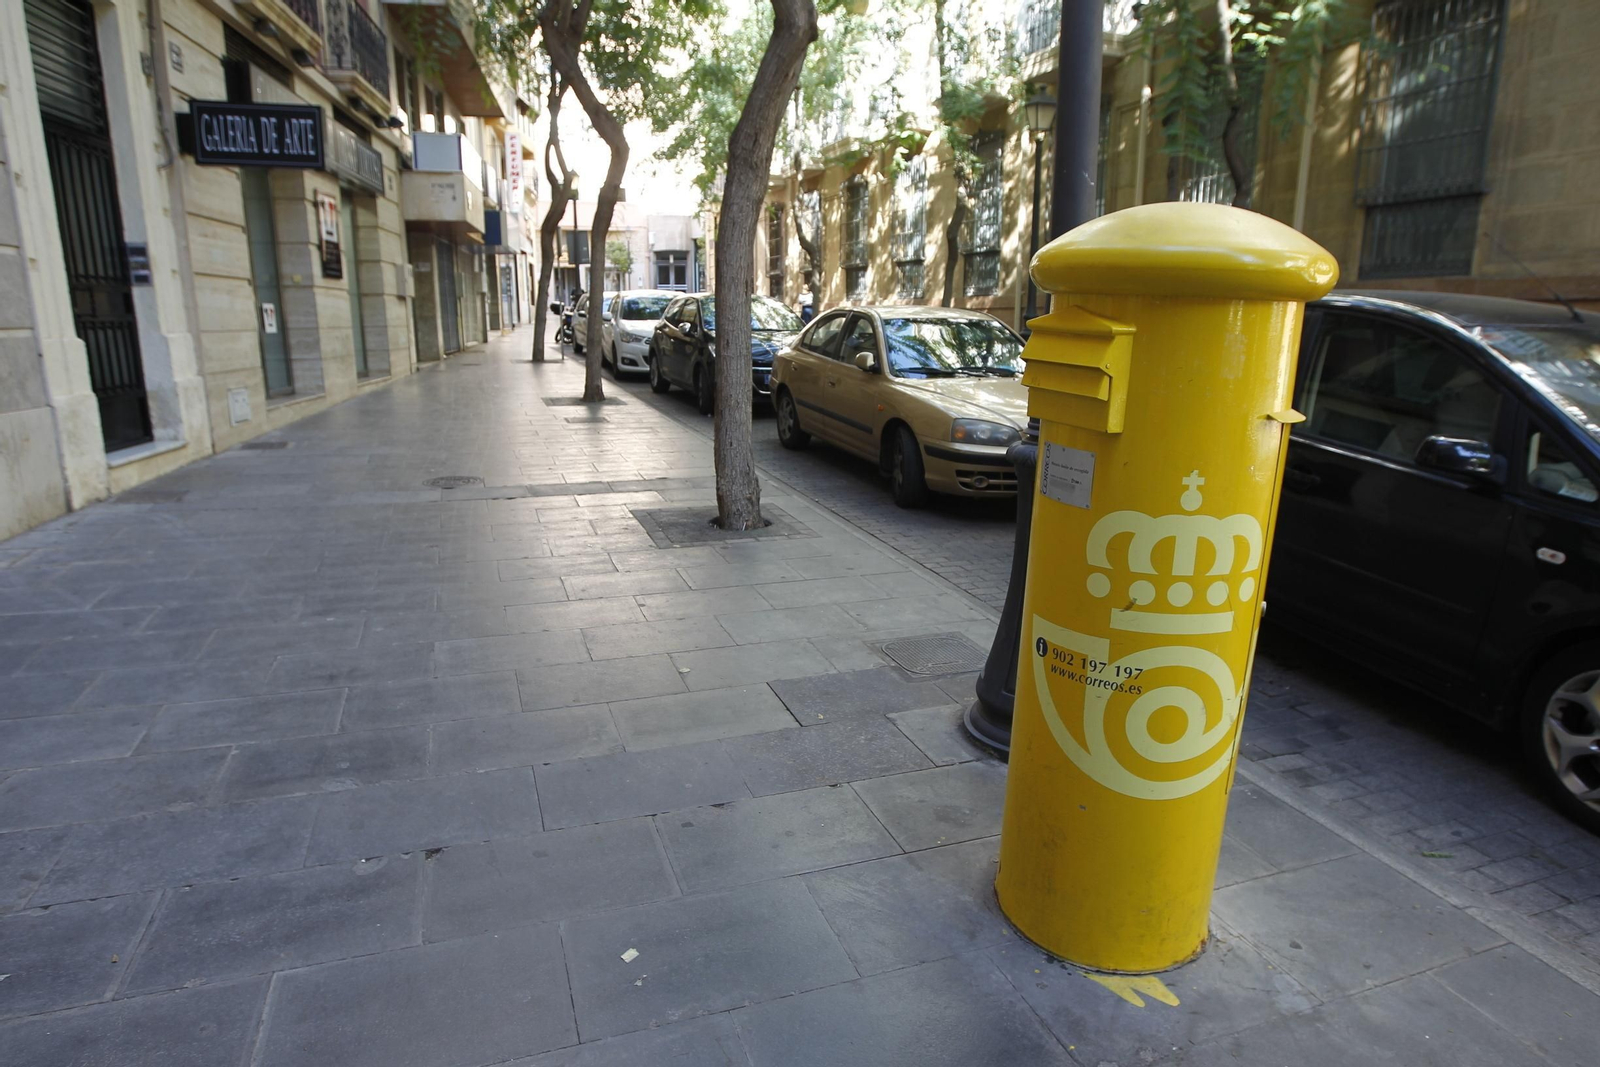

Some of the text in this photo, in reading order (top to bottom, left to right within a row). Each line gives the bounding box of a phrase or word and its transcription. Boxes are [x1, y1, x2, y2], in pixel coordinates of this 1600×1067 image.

[201, 113, 316, 156] GALERIA DE ARTE
[509, 135, 520, 205] PERFUMER
[1042, 443, 1052, 495] CORREOS
[1050, 663, 1143, 695] www.correos.es
[1052, 647, 1074, 667] 902
[1081, 657, 1107, 674] 197
[1115, 665, 1144, 681] 197
